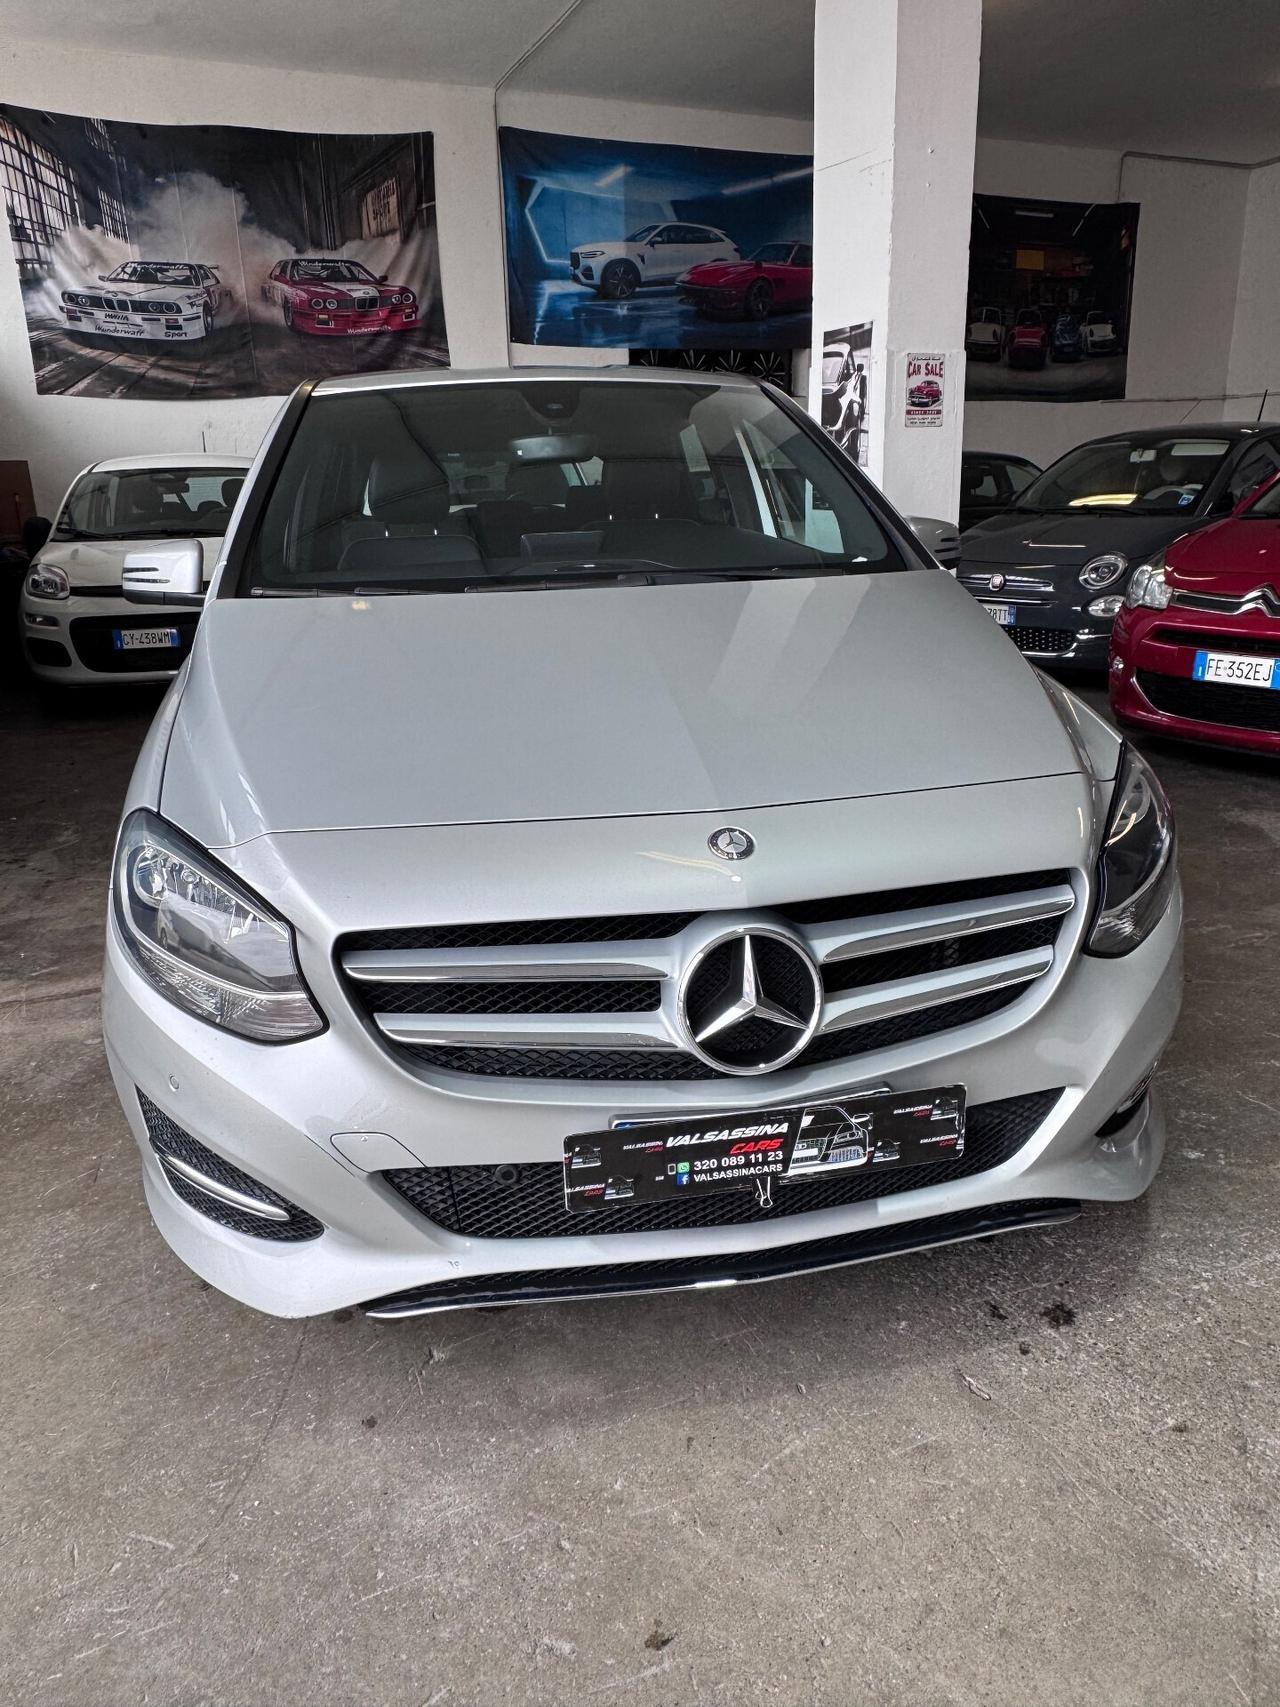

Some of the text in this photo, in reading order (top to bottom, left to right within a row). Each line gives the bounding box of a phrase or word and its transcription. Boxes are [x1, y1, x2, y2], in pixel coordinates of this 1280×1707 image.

[165, 331, 188, 339] Sport
[908, 361, 944, 378] CAR SALE
[666, 1123, 789, 1148] VALSASSINA
[729, 1138, 784, 1155] CARS
[693, 1151, 783, 1171] 320 089 11 23
[693, 1164, 783, 1182] VALSASSINACARS
